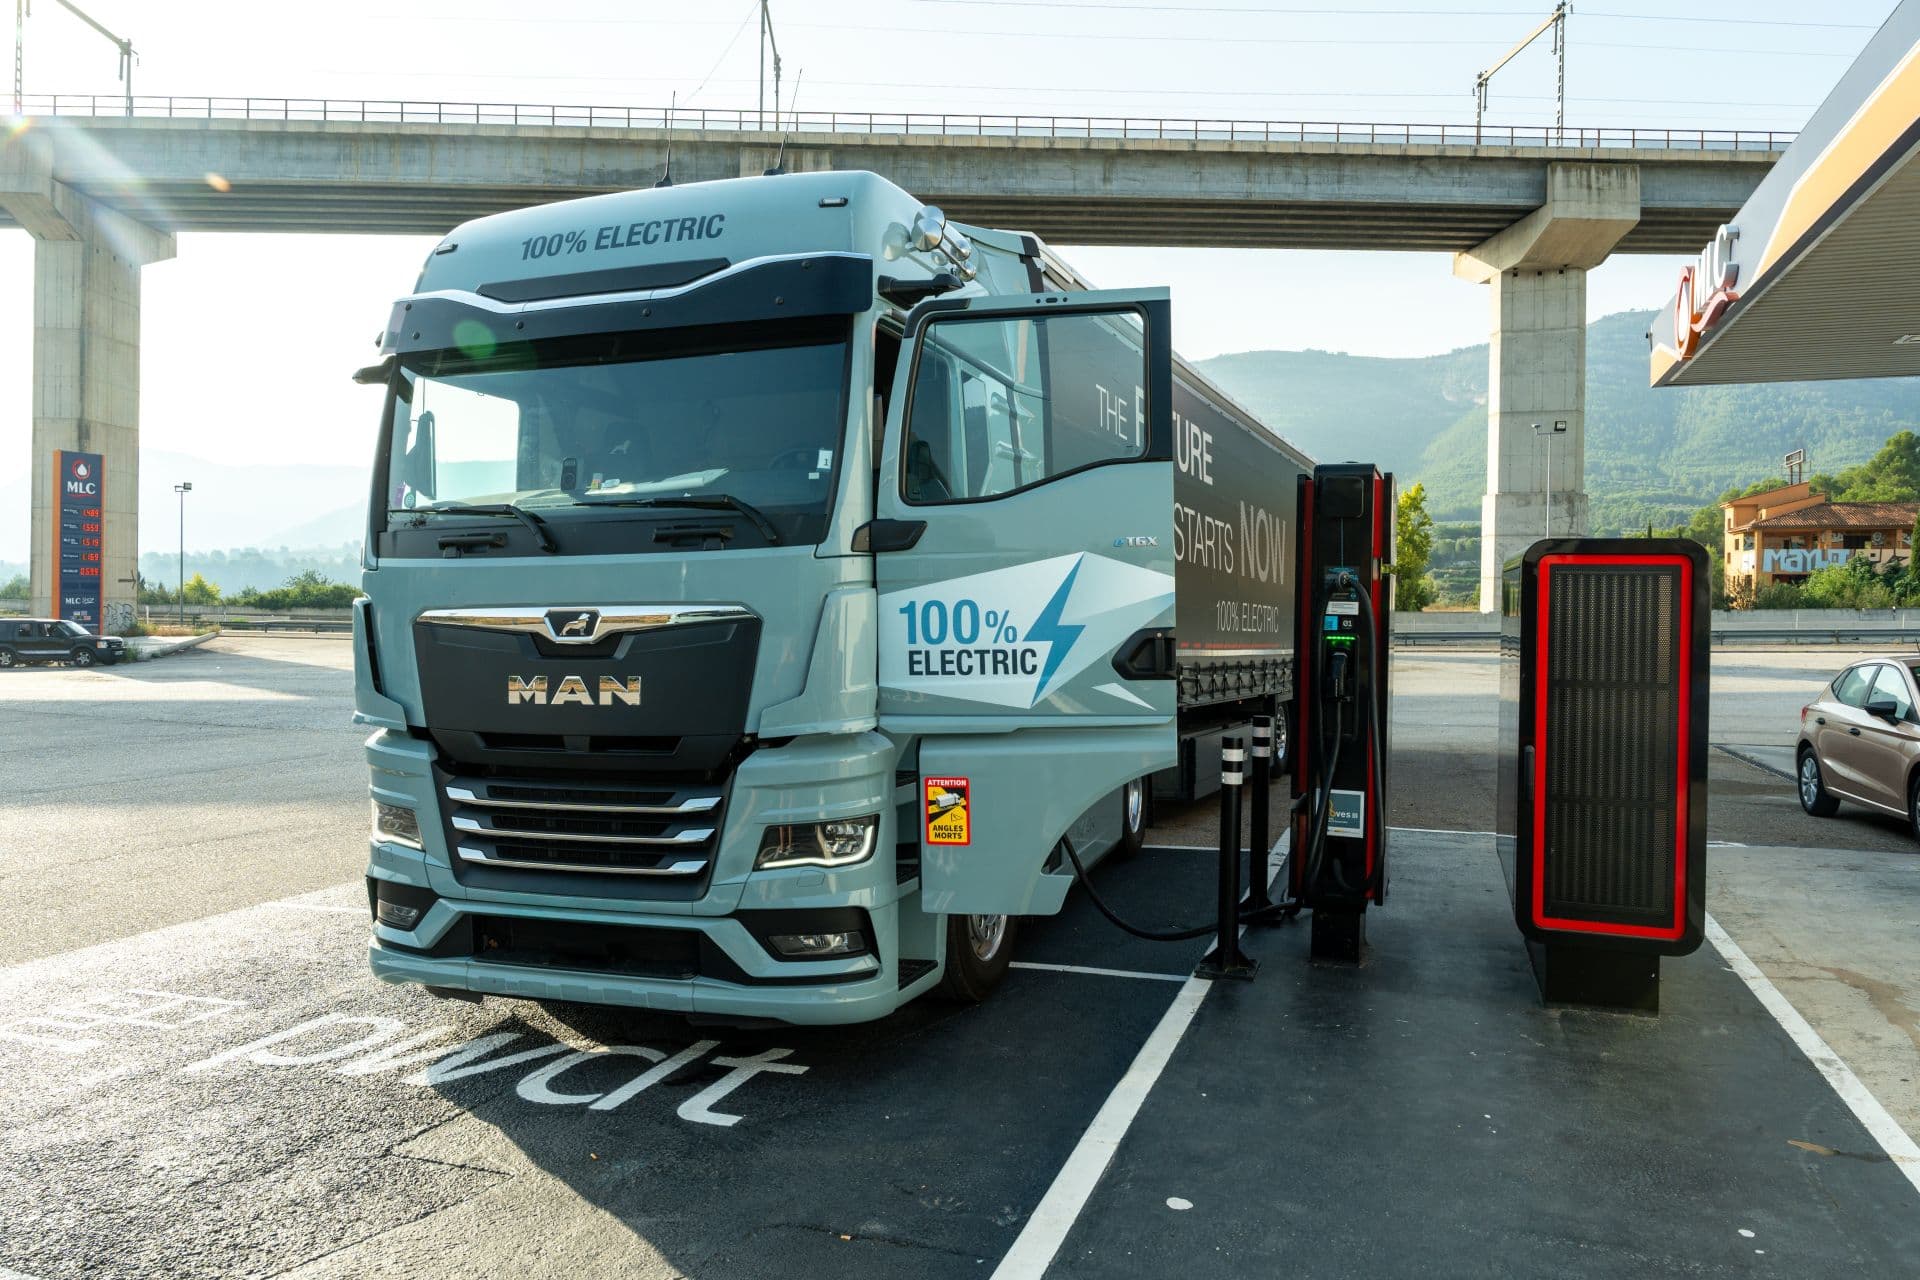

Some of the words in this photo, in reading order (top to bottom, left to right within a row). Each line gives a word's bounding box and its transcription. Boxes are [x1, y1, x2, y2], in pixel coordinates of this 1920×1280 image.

[521, 230, 587, 260] 100%
[595, 214, 725, 250] ELECTRIC
[1096, 384, 1127, 441] THE
[1136, 386, 1213, 485] FURE
[67, 481, 96, 495] MLC
[1174, 503, 1233, 574] STARTS
[1240, 500, 1286, 585] NOW
[900, 600, 1017, 645] 100%
[1216, 600, 1238, 632] 100%
[1242, 602, 1279, 632] ELECTRIC
[909, 649, 1037, 676] ELECTRIC
[508, 676, 641, 705] MAN
